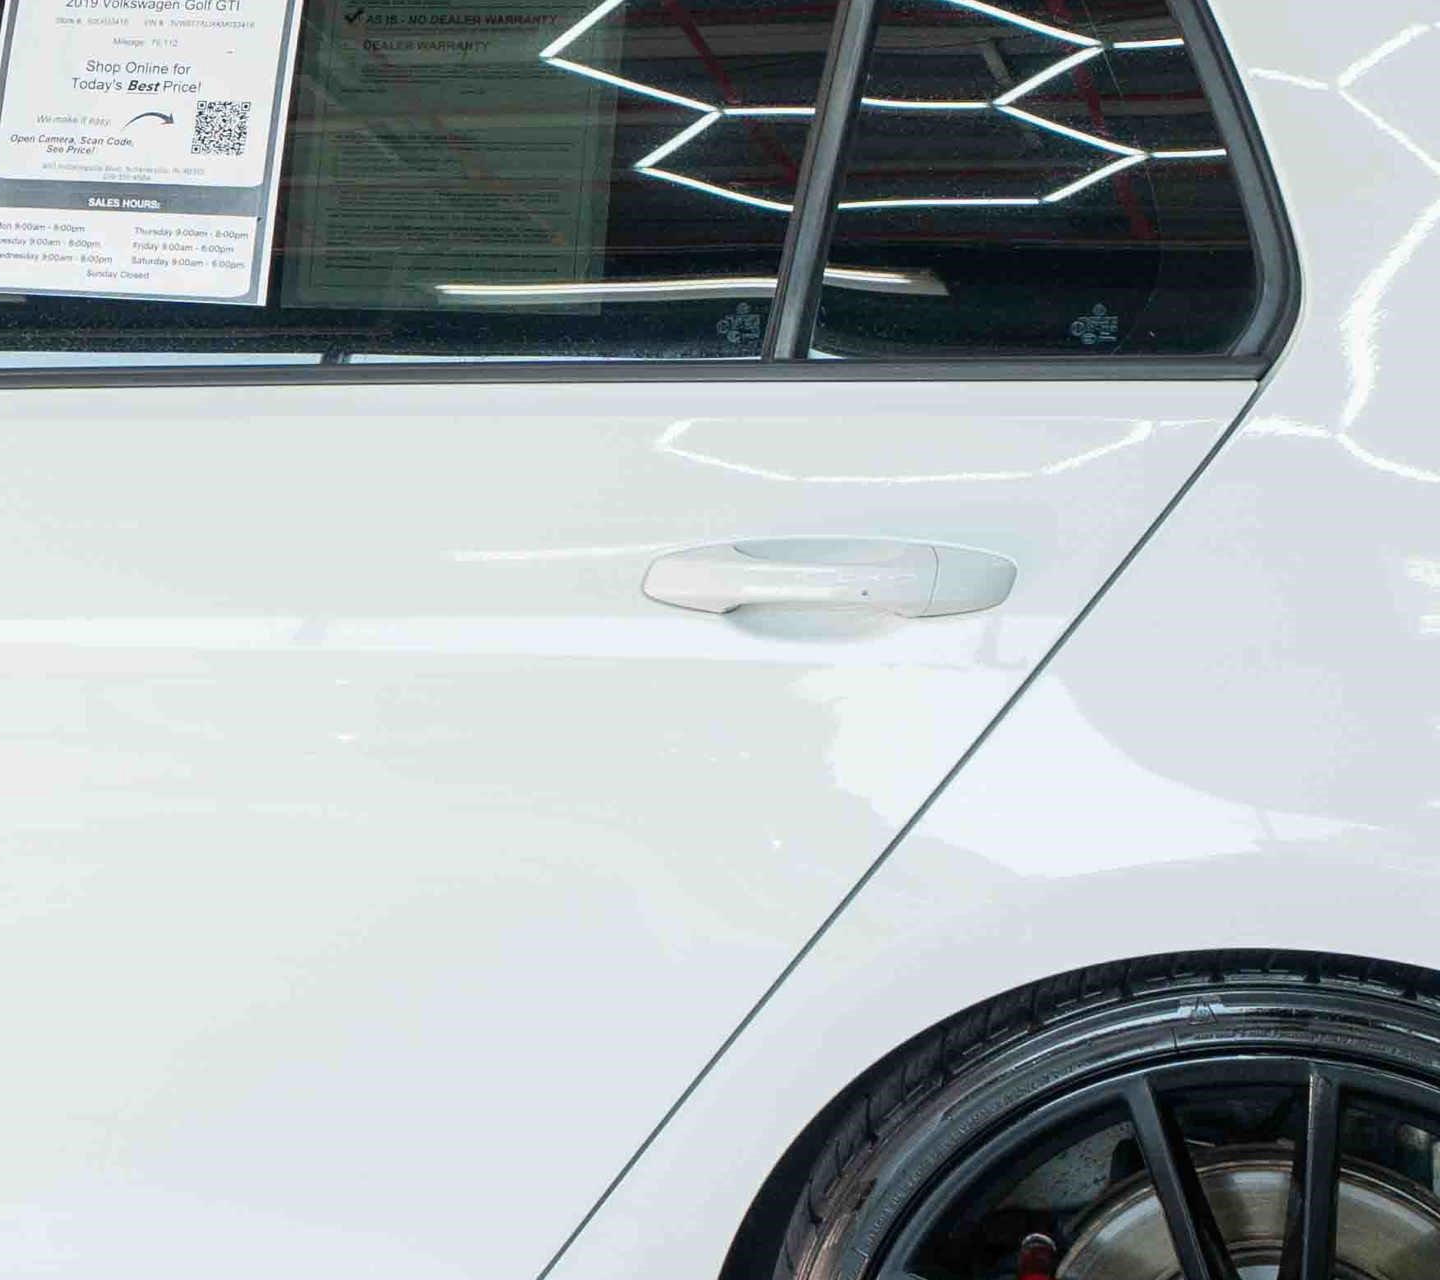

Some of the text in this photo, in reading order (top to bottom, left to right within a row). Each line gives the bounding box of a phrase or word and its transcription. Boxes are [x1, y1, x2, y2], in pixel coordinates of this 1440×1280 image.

[215, 0, 241, 12] GTI
[430, 14, 481, 25] DEALER
[484, 15, 559, 25] WARRANTY
[363, 40, 490, 51] DEALER WARRANTY
[86, 60, 191, 76] Shop Online for
[71, 77, 202, 94] Today's Best Price!
[10, 134, 134, 148] Open Camera, Scan Code,
[46, 144, 96, 155] See Price!
[88, 198, 160, 210] SALES HOURS:
[135, 226, 173, 238] Thursday
[132, 242, 159, 253] Friday
[131, 256, 169, 267] Saturday
[86, 270, 150, 280] Sunday Closed
